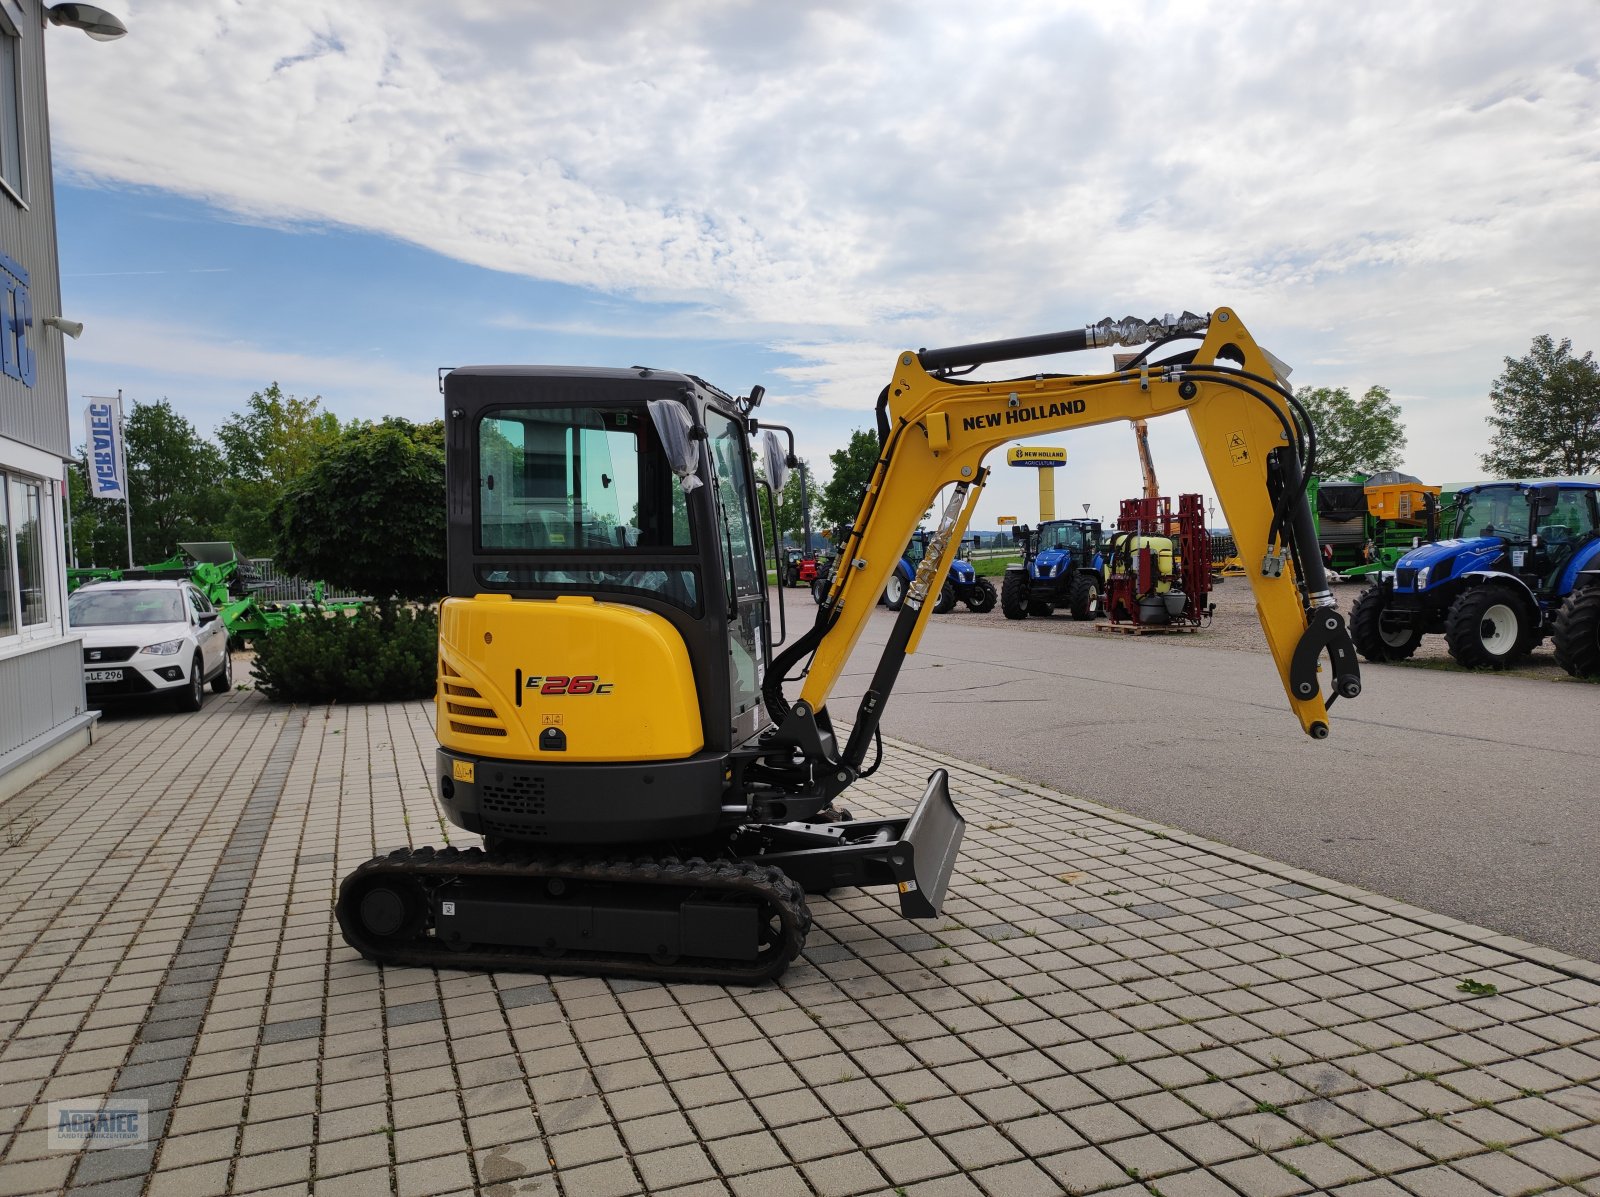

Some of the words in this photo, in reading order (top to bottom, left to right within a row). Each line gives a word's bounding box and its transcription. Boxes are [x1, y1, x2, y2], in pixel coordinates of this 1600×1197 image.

[963, 413, 1002, 431] NEW
[1006, 400, 1086, 424] HOLLAND
[90, 672, 103, 680] LE
[105, 671, 122, 680] 296
